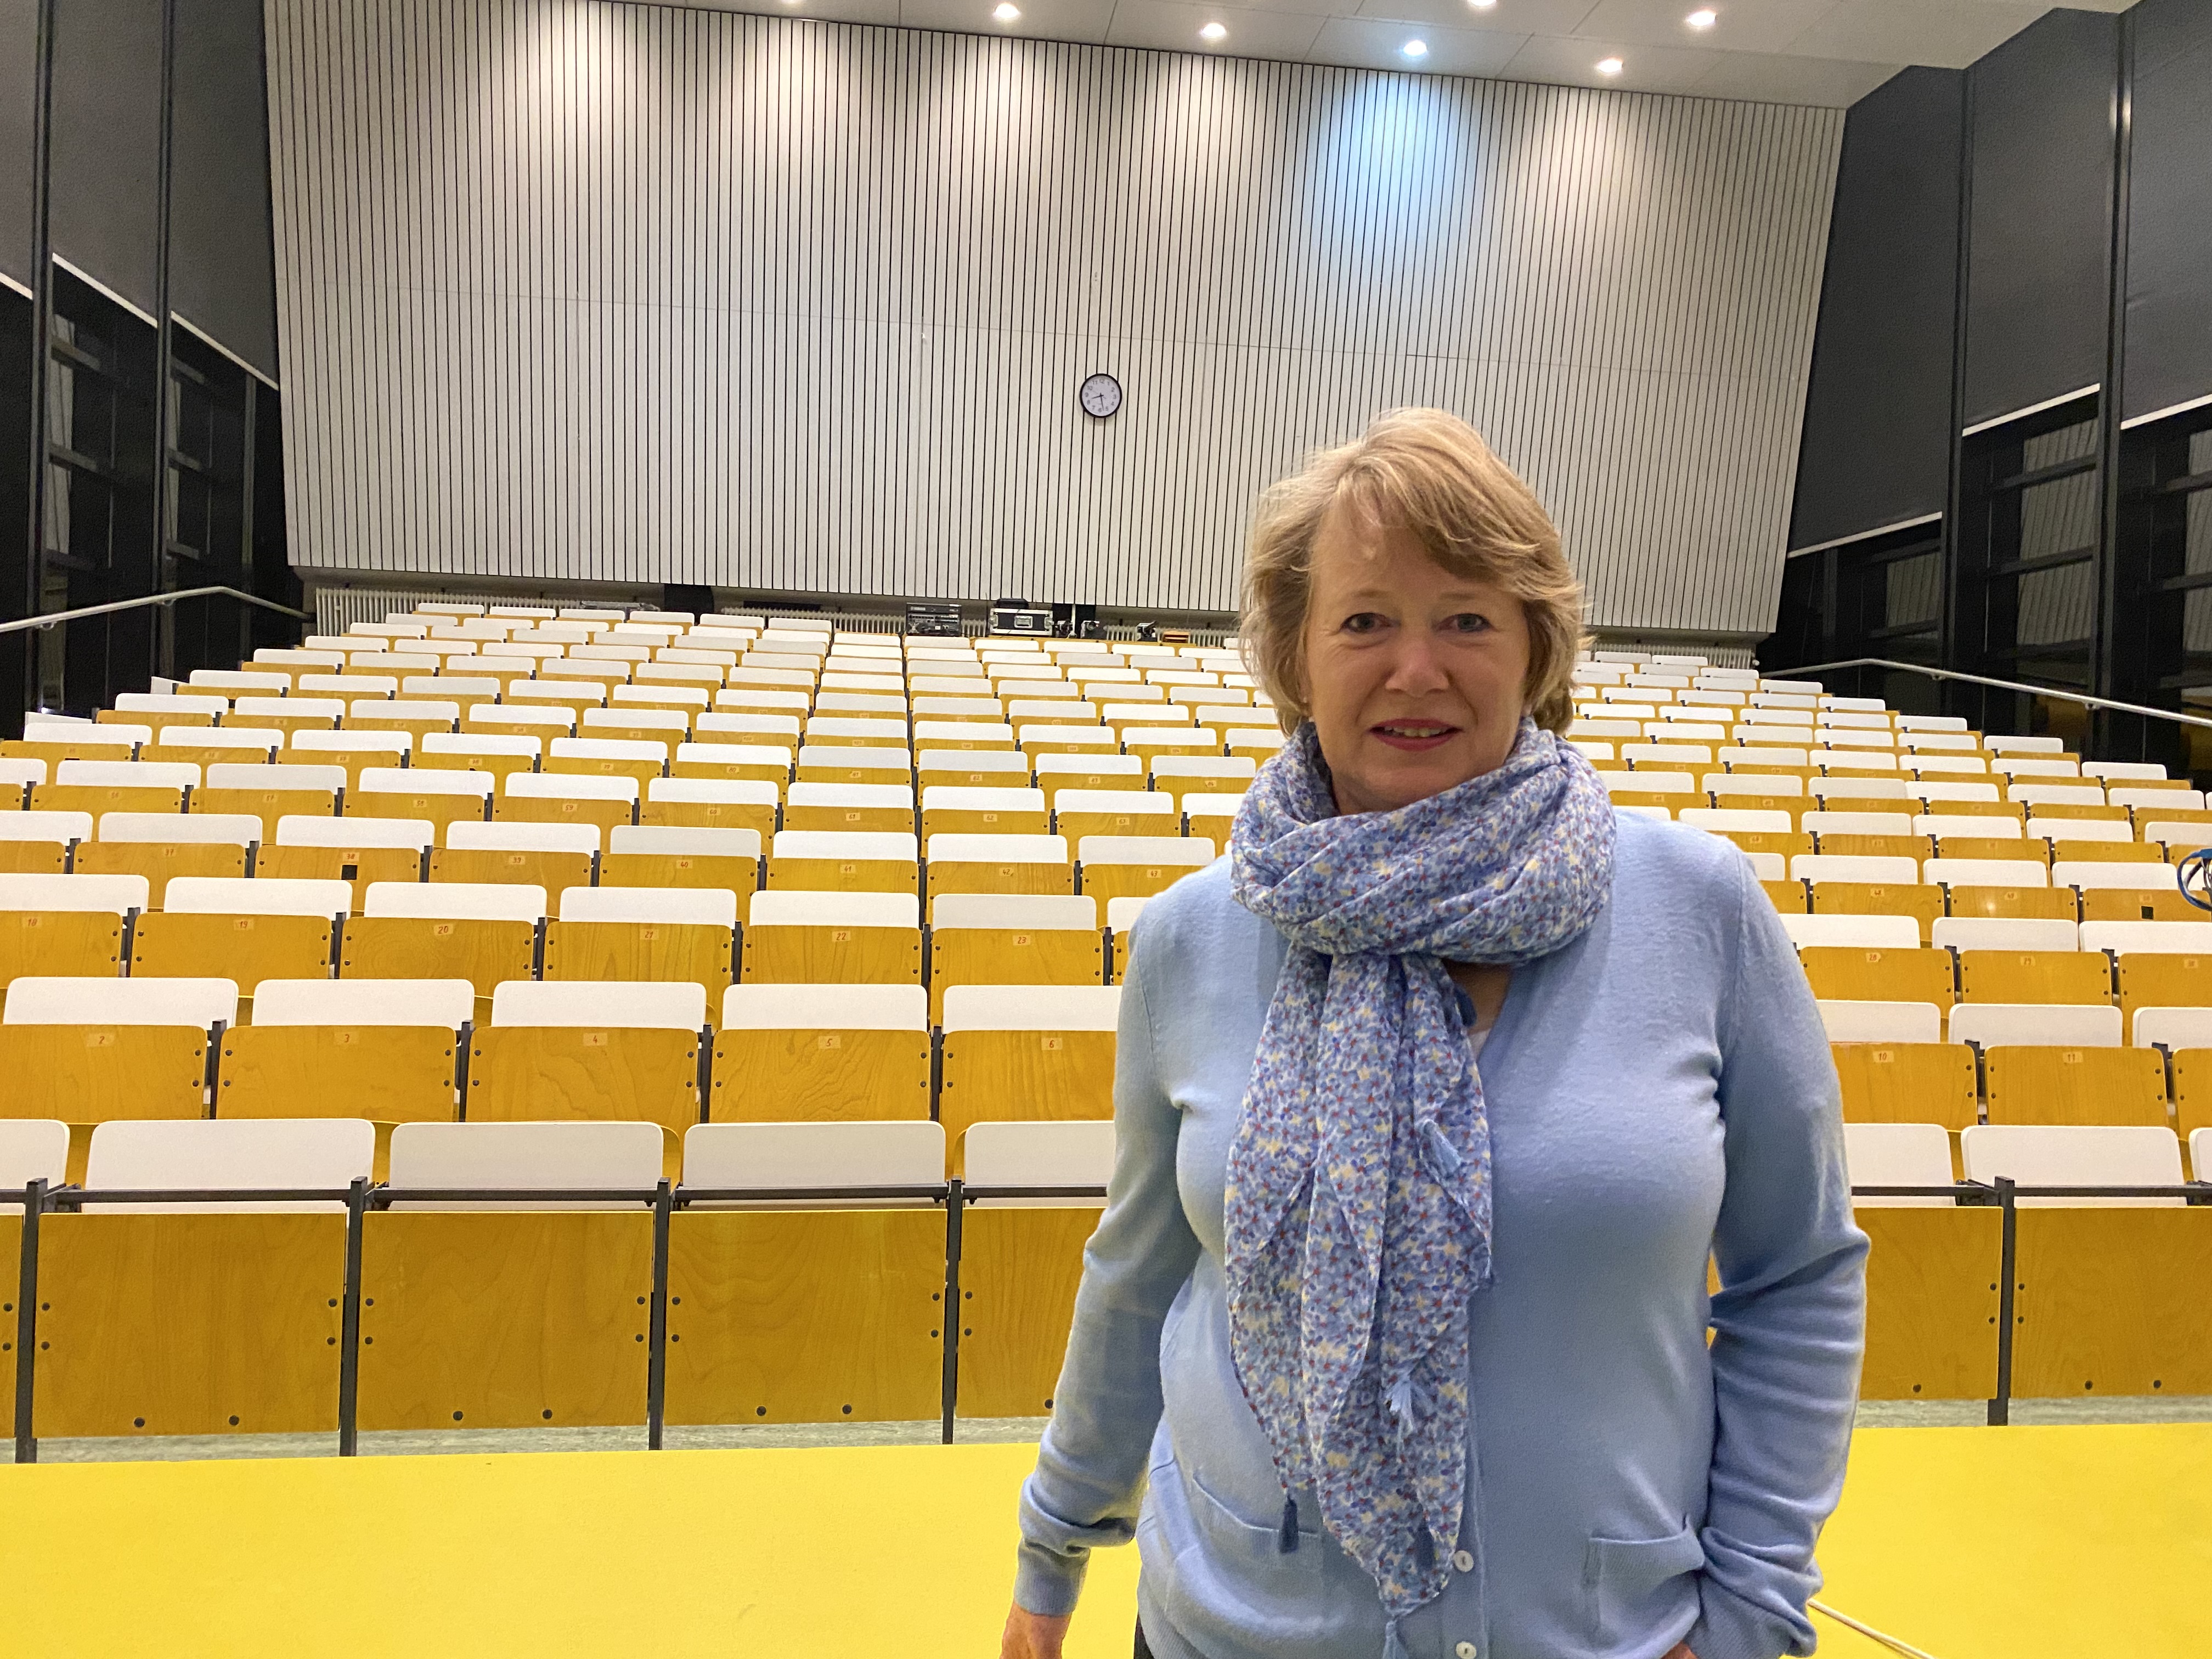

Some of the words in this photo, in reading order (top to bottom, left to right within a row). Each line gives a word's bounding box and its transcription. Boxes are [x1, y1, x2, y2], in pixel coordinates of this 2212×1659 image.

[28, 918, 37, 927] 18
[438, 926, 448, 934] 20
[99, 1036, 105, 1044] 2
[345, 1034, 350, 1042] 3
[593, 1035, 598, 1043] 4
[826, 1038, 832, 1047] 5
[1049, 1040, 1054, 1048] 6
[1878, 1052, 1887, 1061] 10
[2068, 1053, 2075, 1062] 11
